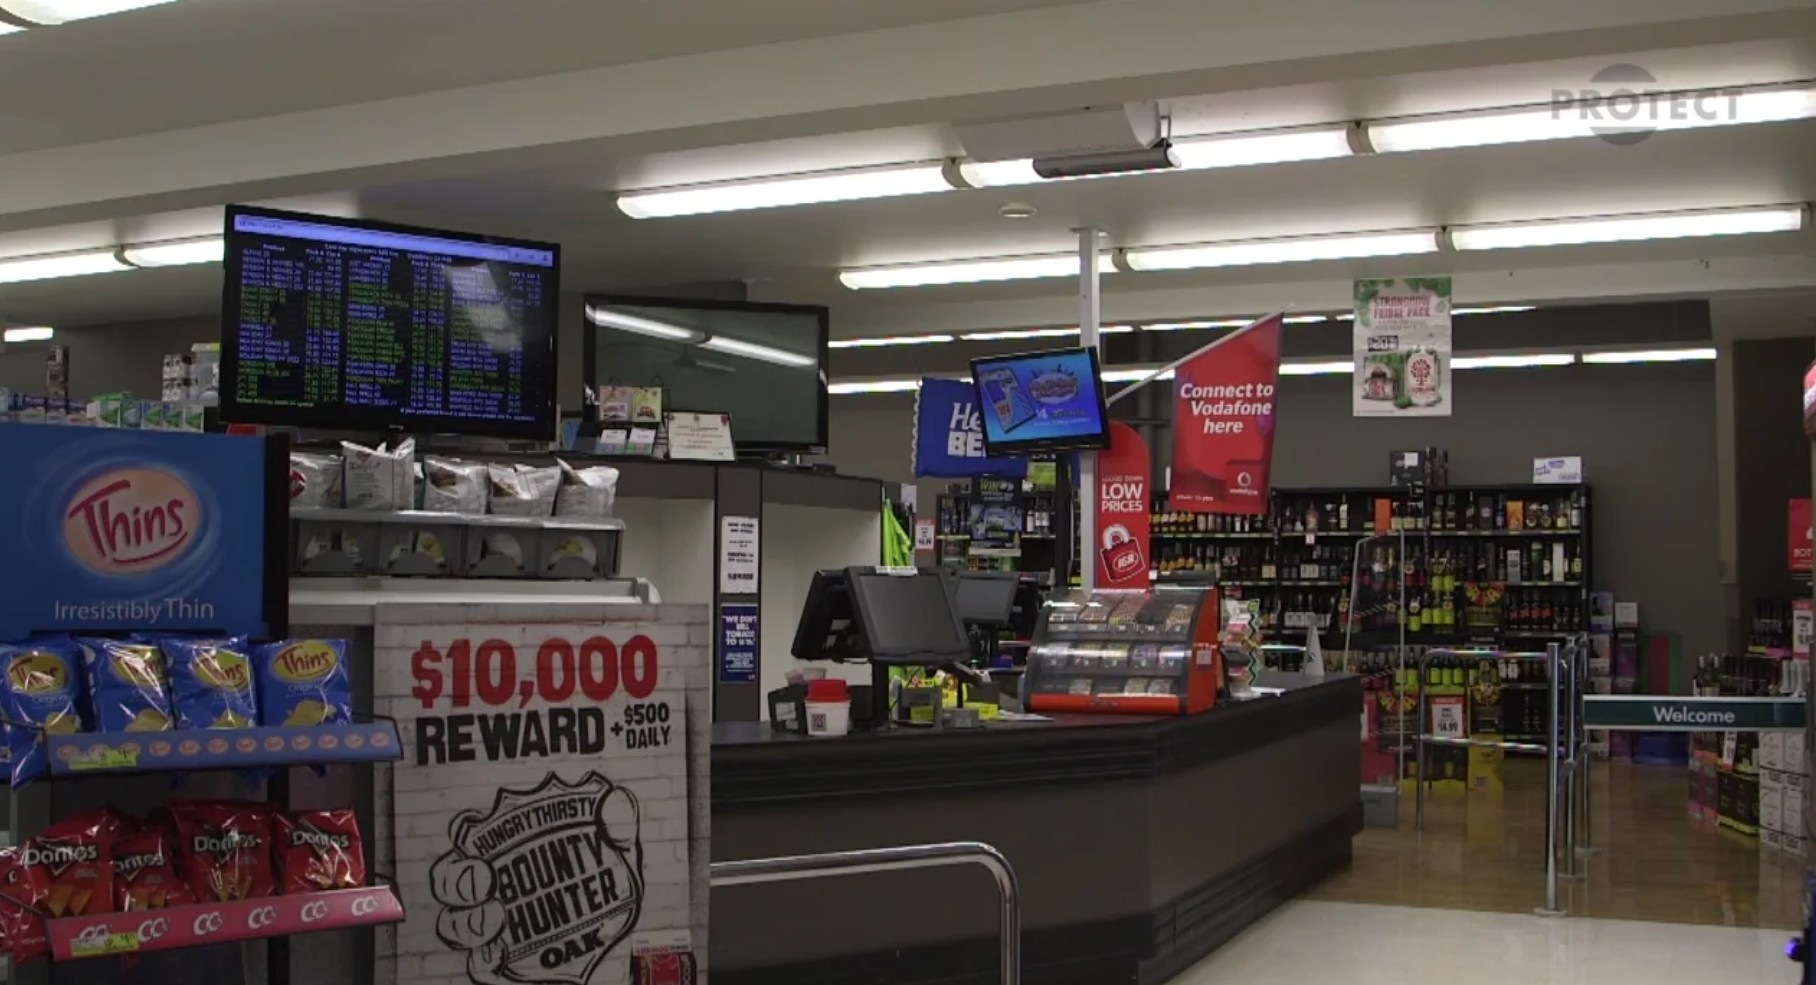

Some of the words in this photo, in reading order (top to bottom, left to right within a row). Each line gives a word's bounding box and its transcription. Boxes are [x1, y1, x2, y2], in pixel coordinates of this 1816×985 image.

[1180, 383, 1253, 398] Connect
[1256, 382, 1274, 398] to
[949, 403, 982, 432] He
[1191, 400, 1272, 416] Vodafone
[1203, 418, 1244, 434] here
[947, 431, 987, 458] BE
[1102, 483, 1143, 499] LOW
[69, 479, 184, 558] Thins
[1102, 501, 1143, 512] PRICES
[1117, 554, 1135, 569] IGA
[54, 599, 161, 624] Irresistibly
[163, 598, 214, 619] Thin
[275, 645, 330, 675] Thins
[411, 635, 657, 709] $10,000
[624, 703, 669, 726] $500
[1653, 705, 1736, 723] Welcome
[416, 707, 605, 766] REWARD
[626, 725, 671, 750] DAILY
[115, 853, 166, 872] oritos
[497, 828, 604, 905] BOUNTY
[507, 867, 619, 945] HUNTER
[540, 928, 604, 969] OAK
